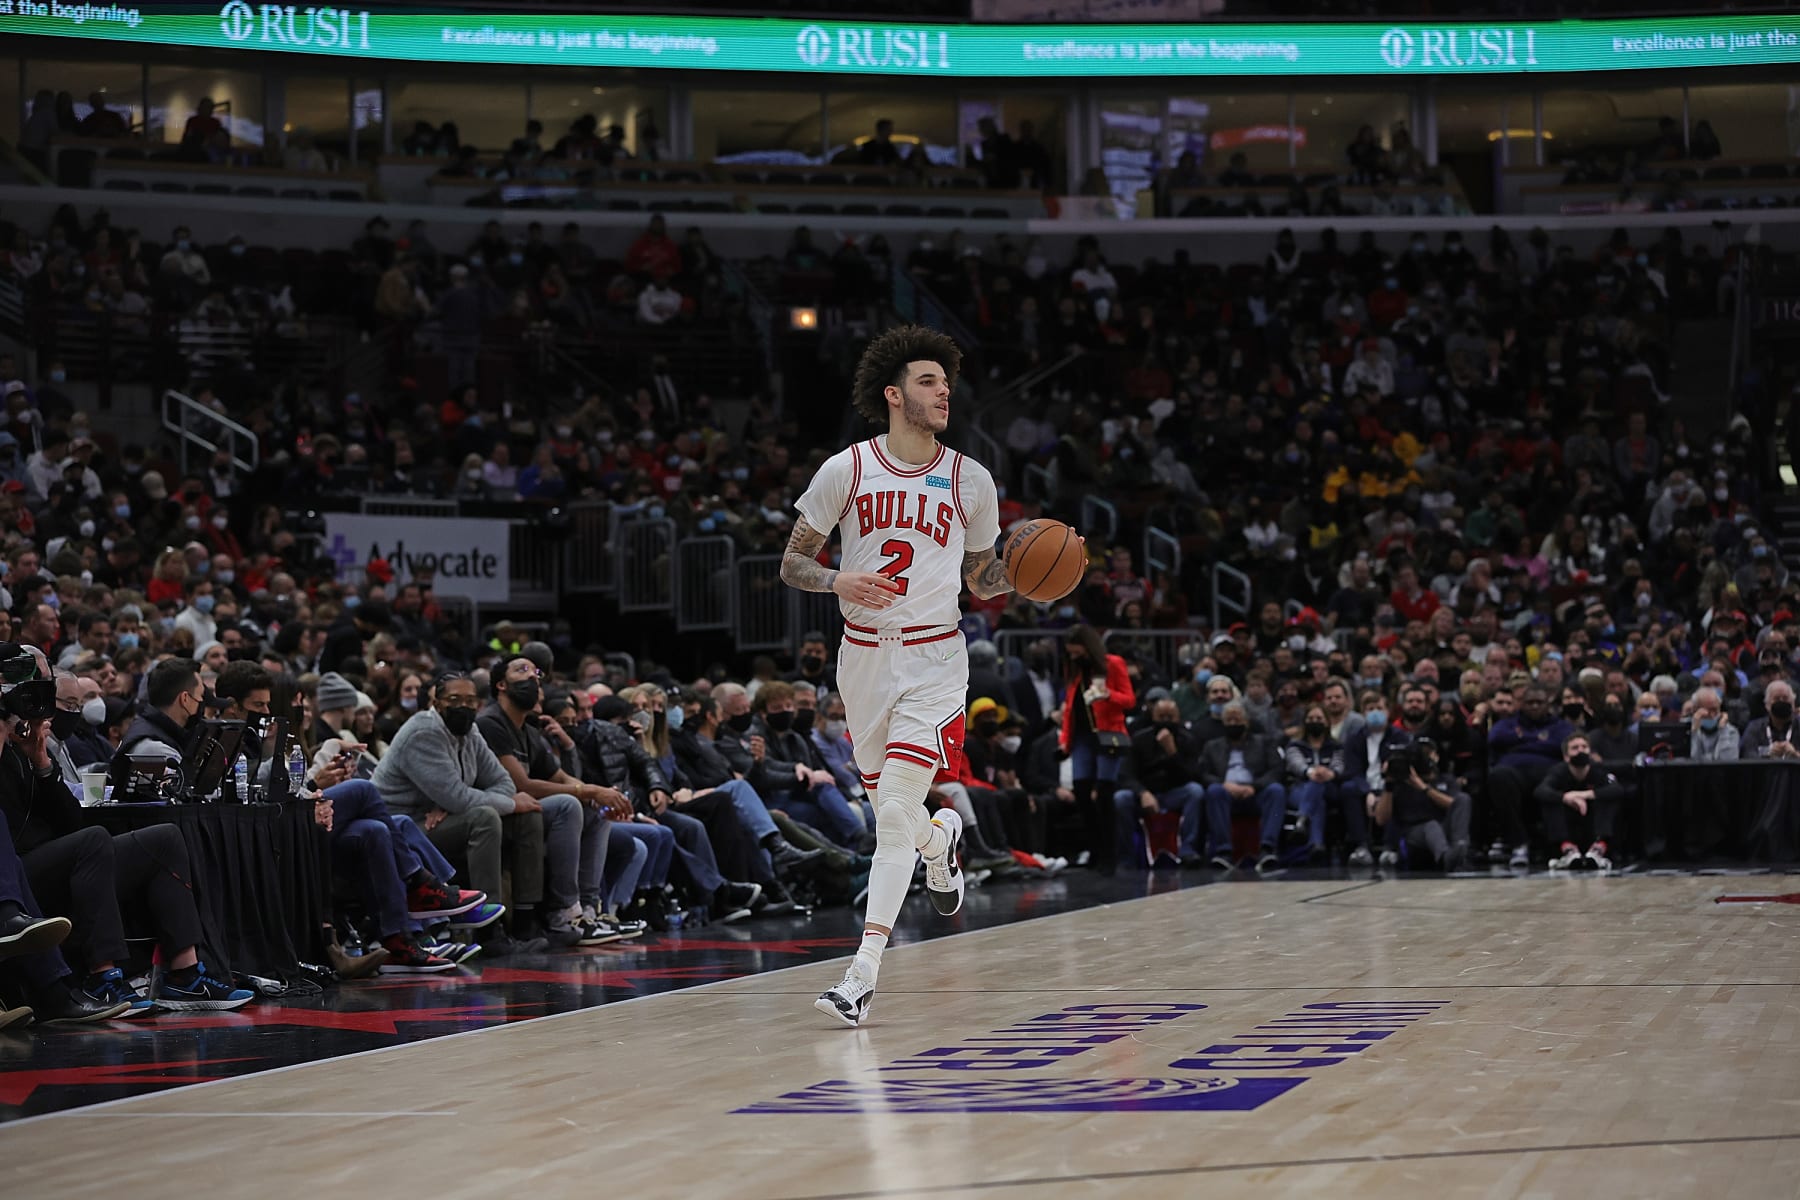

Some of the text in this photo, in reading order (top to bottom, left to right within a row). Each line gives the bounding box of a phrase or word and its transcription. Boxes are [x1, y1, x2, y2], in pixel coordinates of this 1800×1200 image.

[17, 0, 49, 16] the
[51, 0, 144, 27] beginning.
[260, 4, 371, 50] RUSH
[441, 25, 535, 46] Excellence
[538, 29, 555, 47] is
[556, 30, 593, 52] just
[595, 29, 627, 49] the
[837, 28, 950, 68] RUSH
[1023, 40, 1115, 60] Excellence
[1119, 42, 1136, 59] is
[1138, 41, 1173, 63] just
[1176, 40, 1207, 59] the
[1421, 28, 1539, 67] RUSH
[1612, 28, 1798, 53] Excellence is just the
[856, 491, 953, 548] BULLS
[876, 539, 915, 597] 2
[873, 1003, 1209, 1071] CENTER
[1168, 1000, 1453, 1070] UNITED
